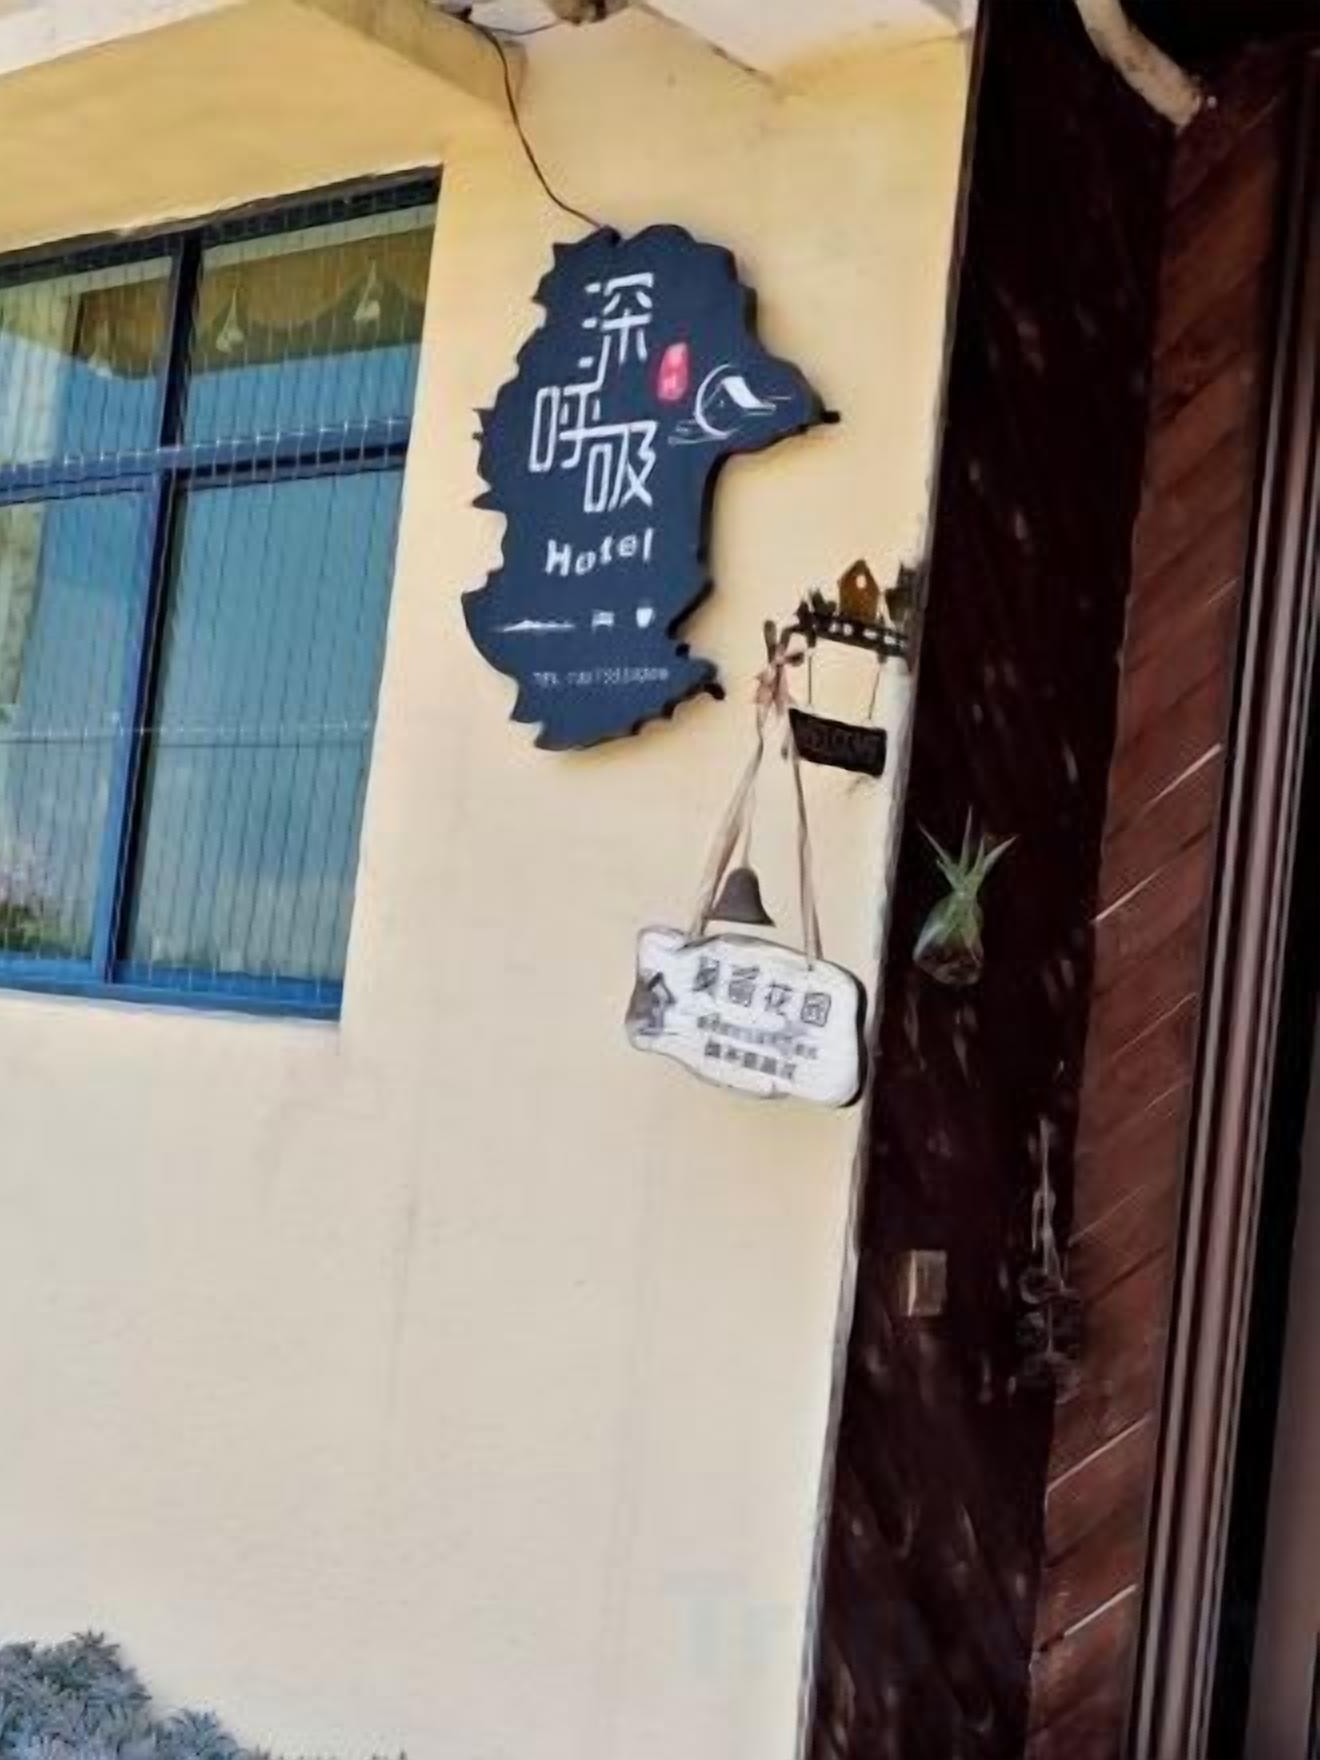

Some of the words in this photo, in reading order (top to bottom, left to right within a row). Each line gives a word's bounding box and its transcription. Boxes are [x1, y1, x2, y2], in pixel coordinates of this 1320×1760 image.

[528, 272, 655, 514] 深呼吸
[544, 528, 654, 577] Hotel
